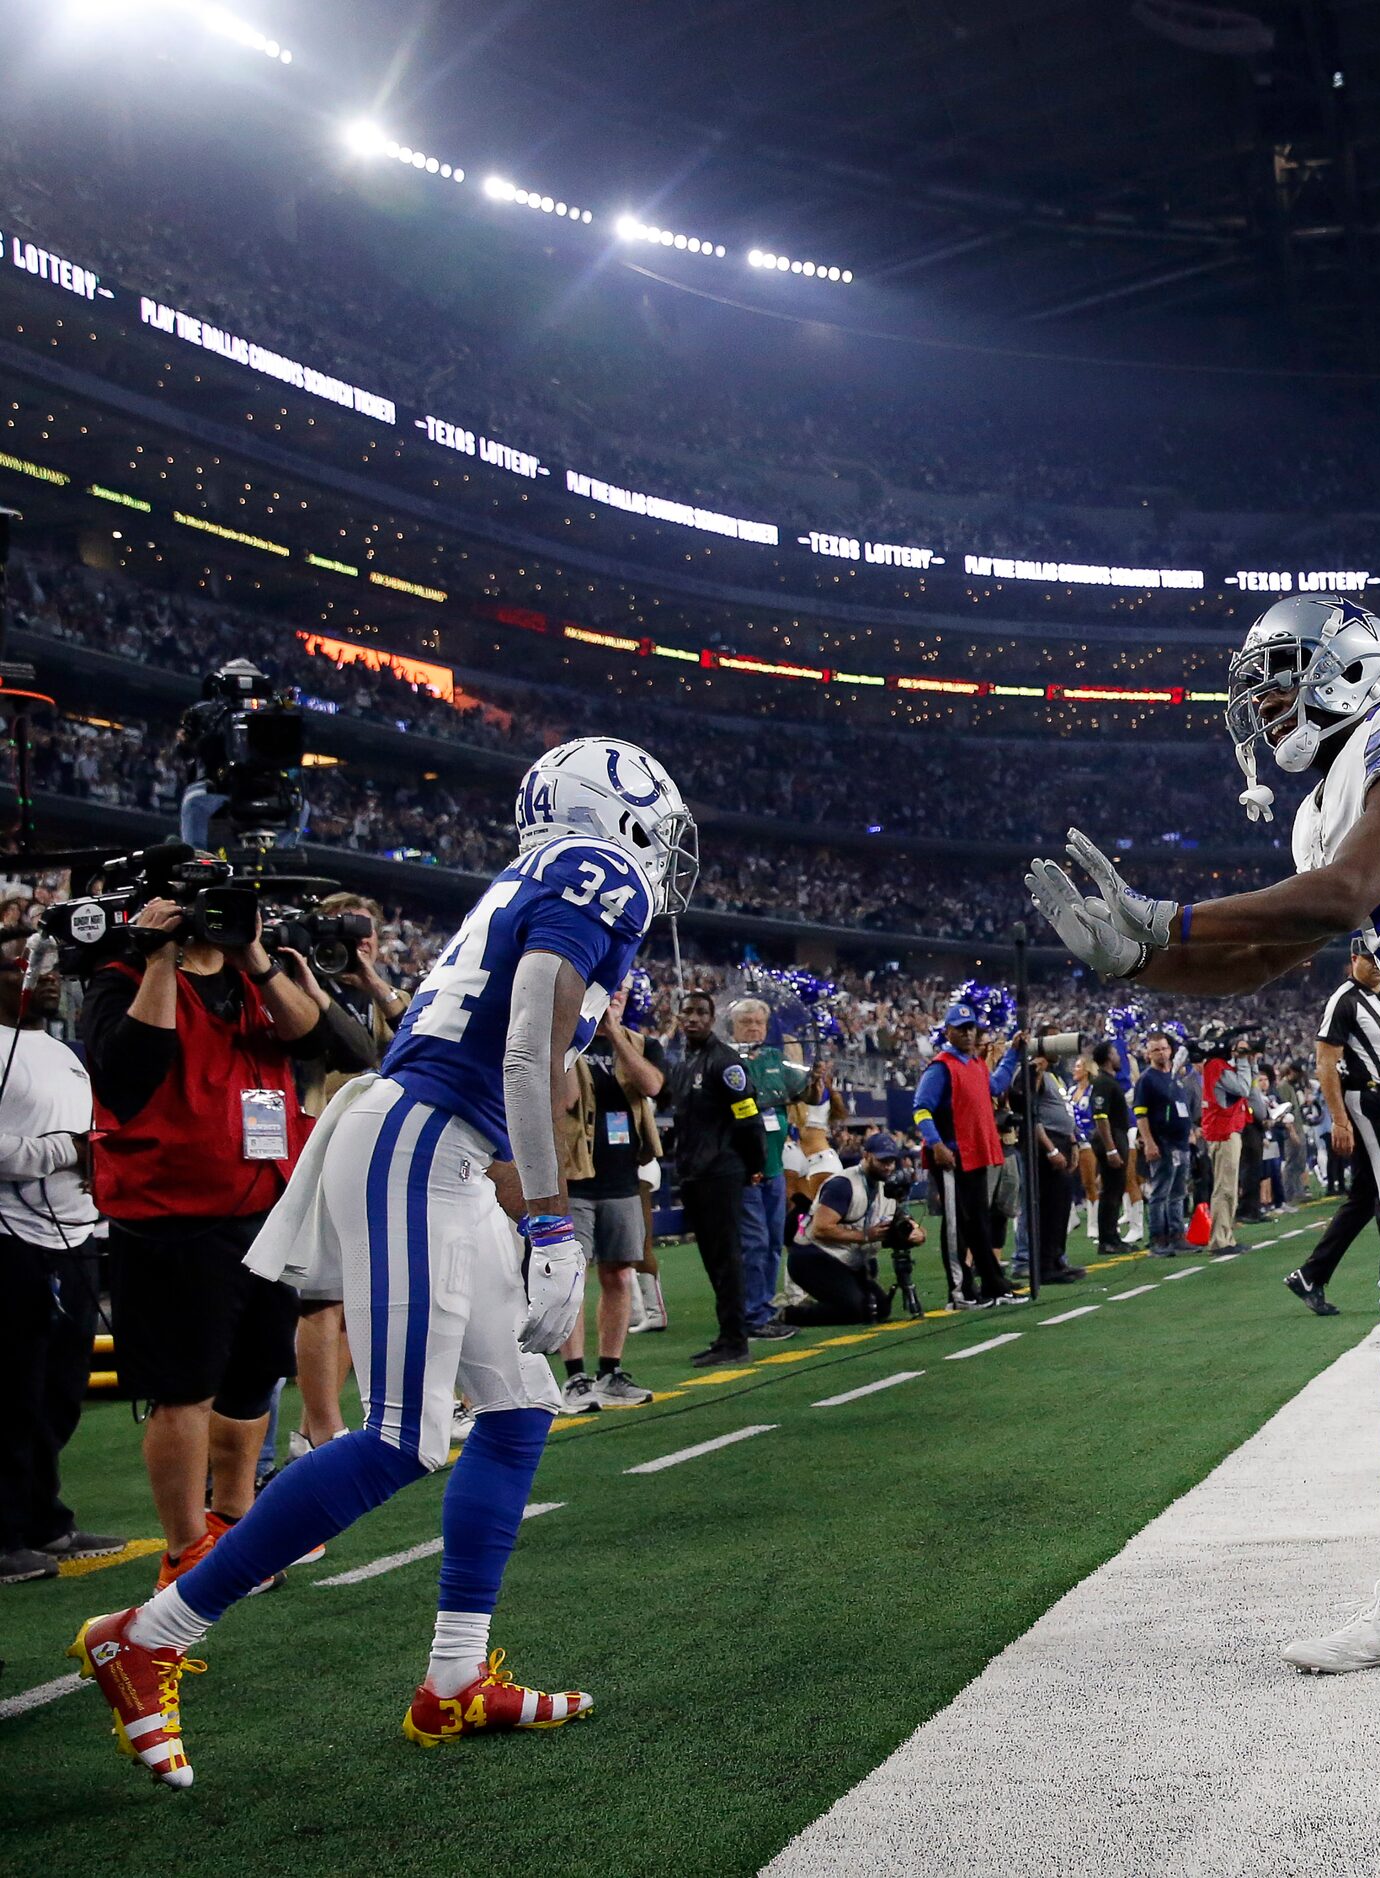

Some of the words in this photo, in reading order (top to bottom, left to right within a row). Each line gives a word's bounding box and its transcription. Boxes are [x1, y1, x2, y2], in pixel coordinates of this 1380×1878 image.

[141, 296, 176, 333] PLAY
[176, 311, 202, 345] THE
[202, 323, 249, 365] DALLAS
[562, 860, 637, 927] 34
[439, 1694, 487, 1734] 34
